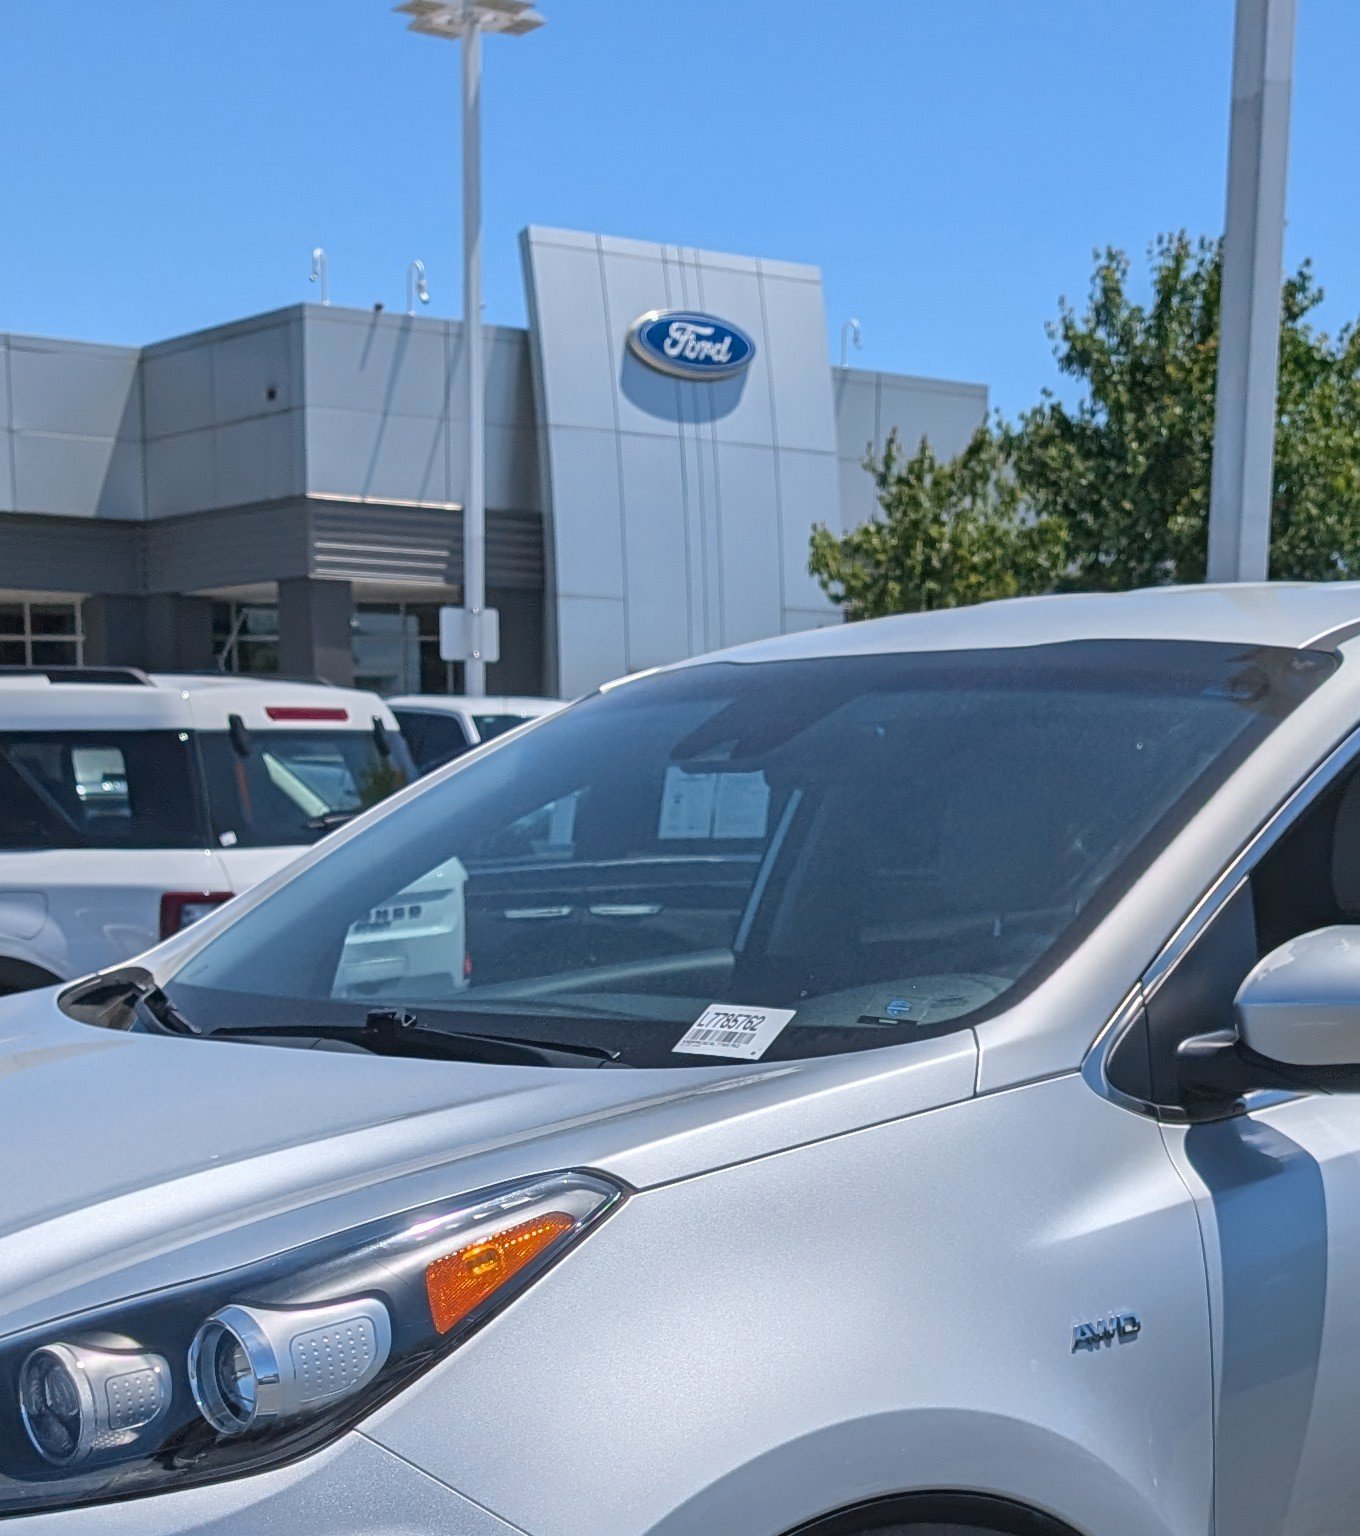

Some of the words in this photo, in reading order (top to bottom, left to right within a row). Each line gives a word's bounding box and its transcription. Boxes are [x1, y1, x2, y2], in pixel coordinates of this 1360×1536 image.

[663, 321, 733, 363] Ford
[696, 1011, 767, 1032] L7785762
[1071, 1314, 1141, 1354] AWD
